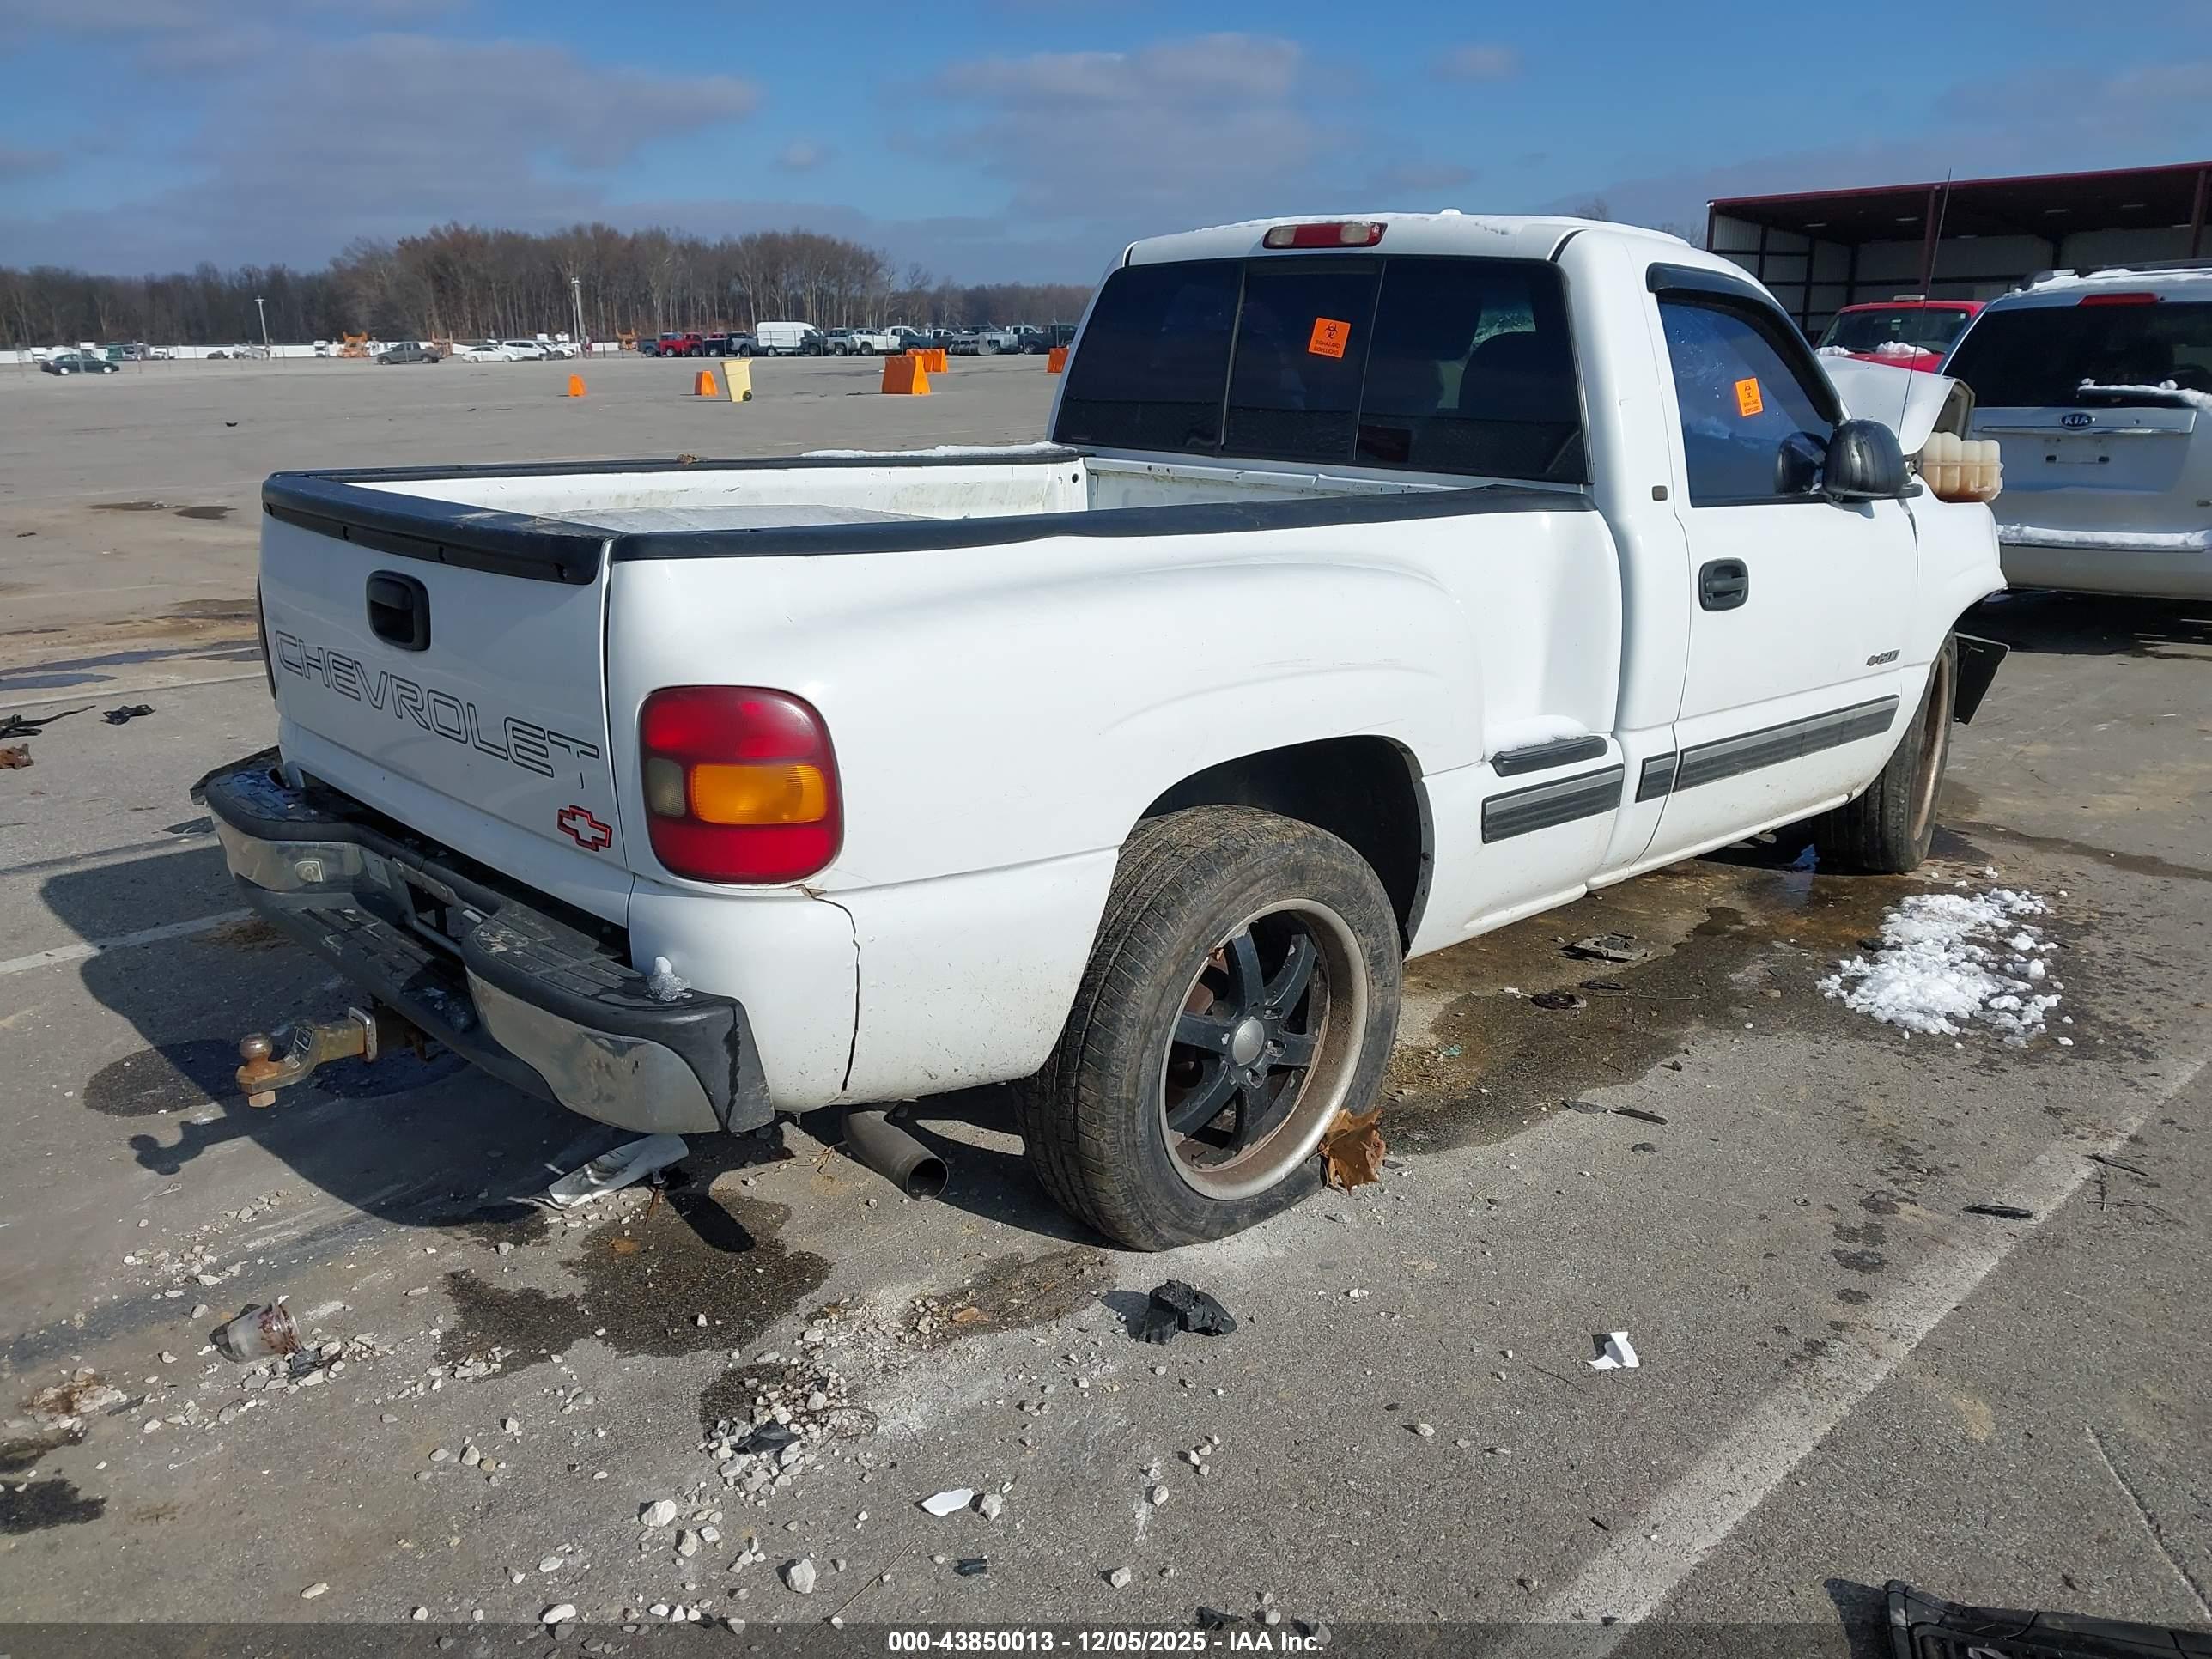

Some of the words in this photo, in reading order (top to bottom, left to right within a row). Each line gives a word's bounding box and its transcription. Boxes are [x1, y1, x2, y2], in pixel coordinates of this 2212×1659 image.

[2063, 416, 2089, 426] KIA
[1877, 649, 1900, 665] 1500
[275, 629, 600, 789] CHEVROLET
